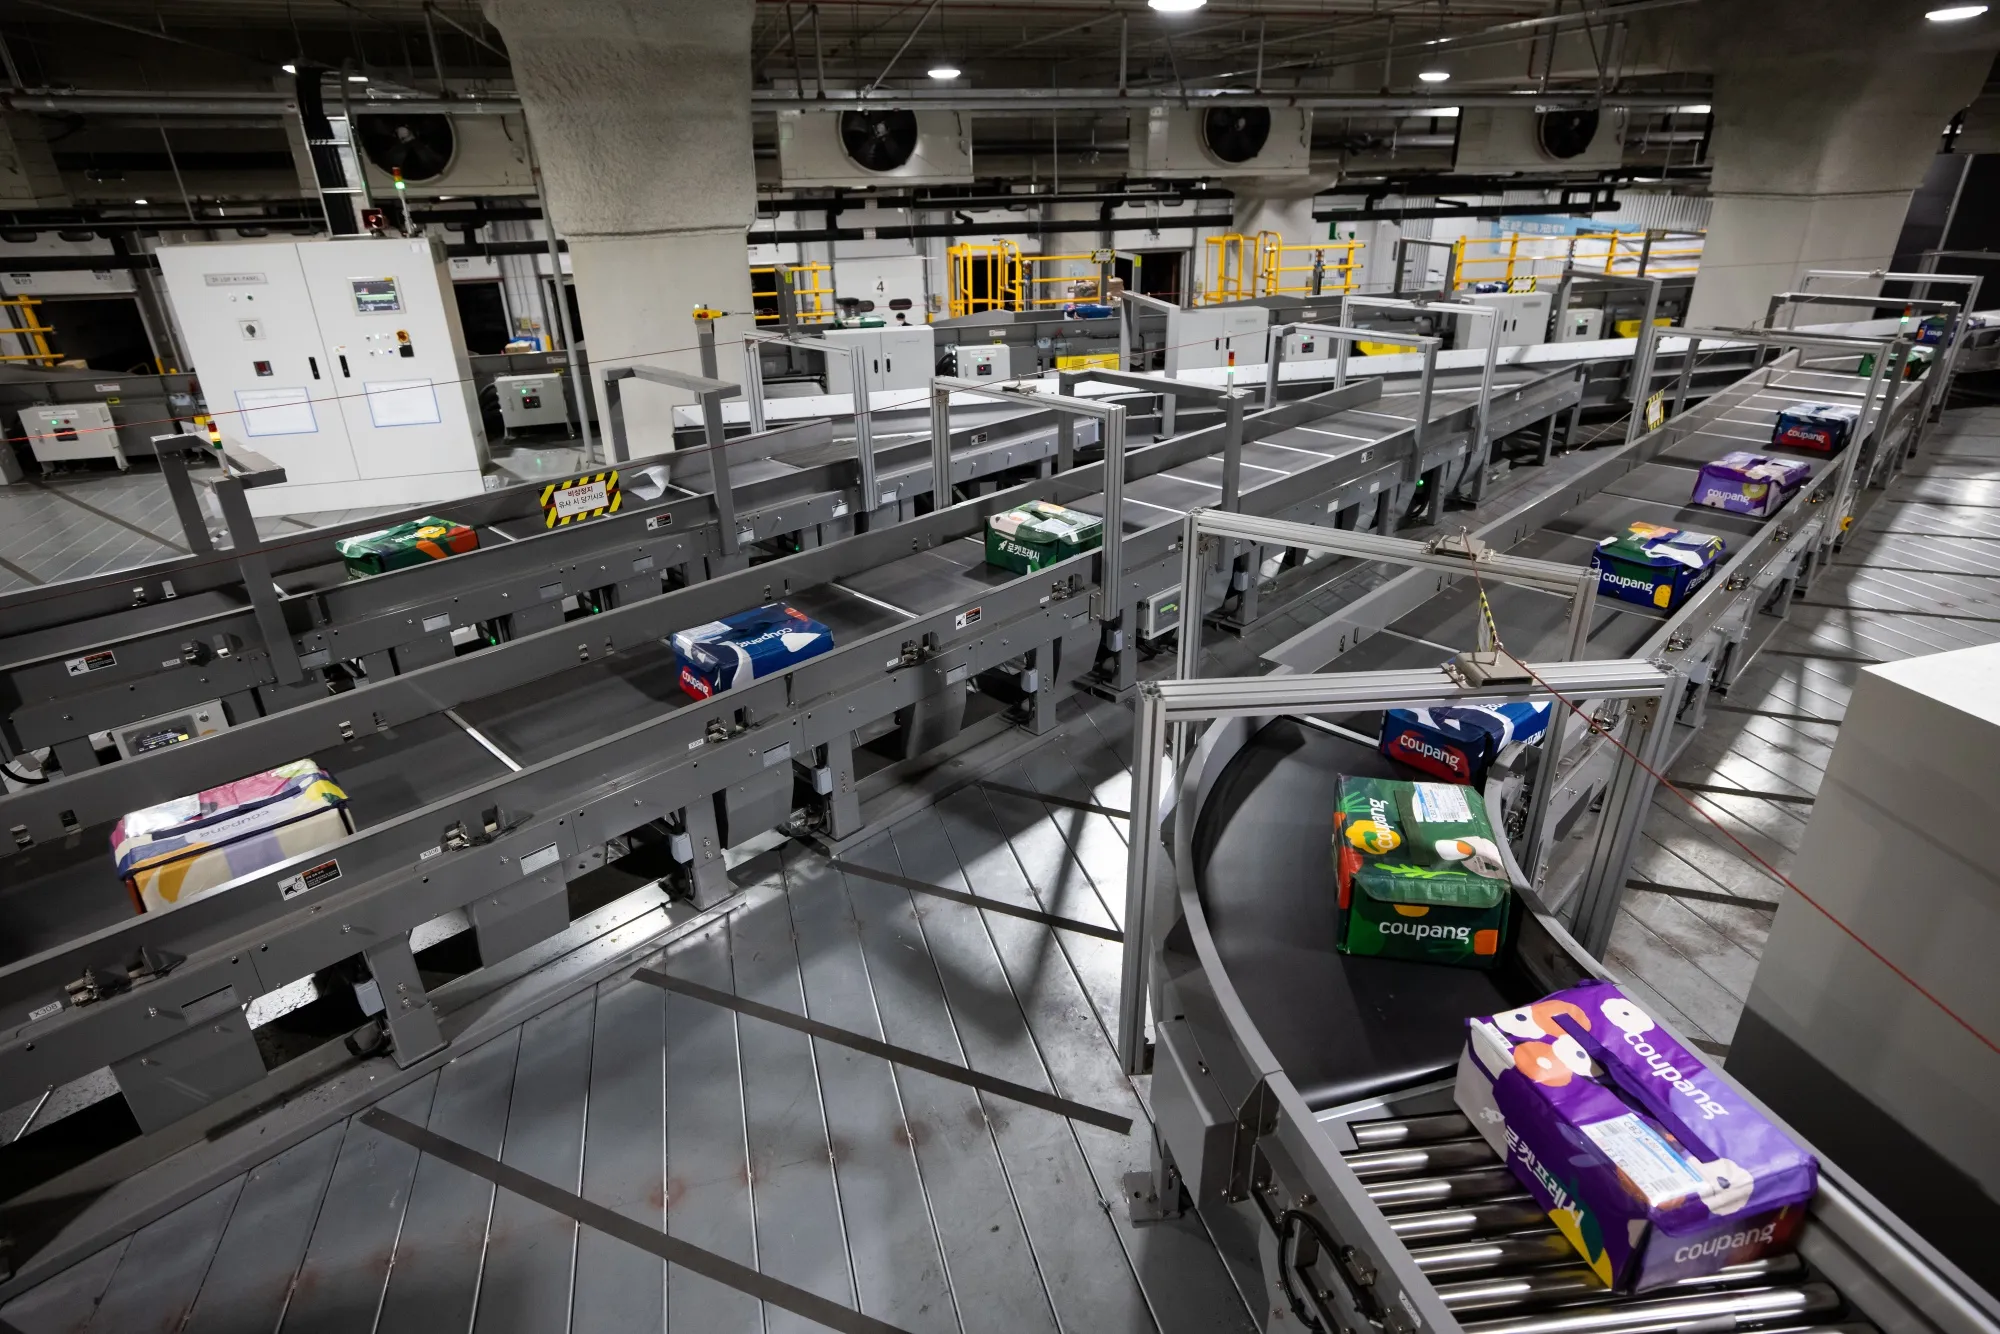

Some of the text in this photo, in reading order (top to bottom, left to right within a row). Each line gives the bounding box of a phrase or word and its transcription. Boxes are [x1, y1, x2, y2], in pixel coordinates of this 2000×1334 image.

[876, 280, 885, 292] 4
[1926, 330, 1943, 338] coup
[1788, 429, 1826, 444] coupang
[567, 485, 594, 498] 비상정지
[580, 491, 605, 504] 당기시오
[1707, 488, 1751, 505] coupang
[1007, 542, 1040, 562] 로켓프레시
[1602, 572, 1654, 594] coupang
[736, 627, 793, 648] coupang
[682, 670, 710, 698] coupang
[1400, 734, 1460, 771] coupang
[200, 810, 269, 838] coupang
[1370, 797, 1394, 849] coupang
[1379, 921, 1471, 944] coupang
[33, 1003, 58, 1018] X308
[1624, 1032, 1729, 1120] coupang
[1502, 1124, 1585, 1229] 로켓프레시
[1675, 1222, 1776, 1263] coupang
